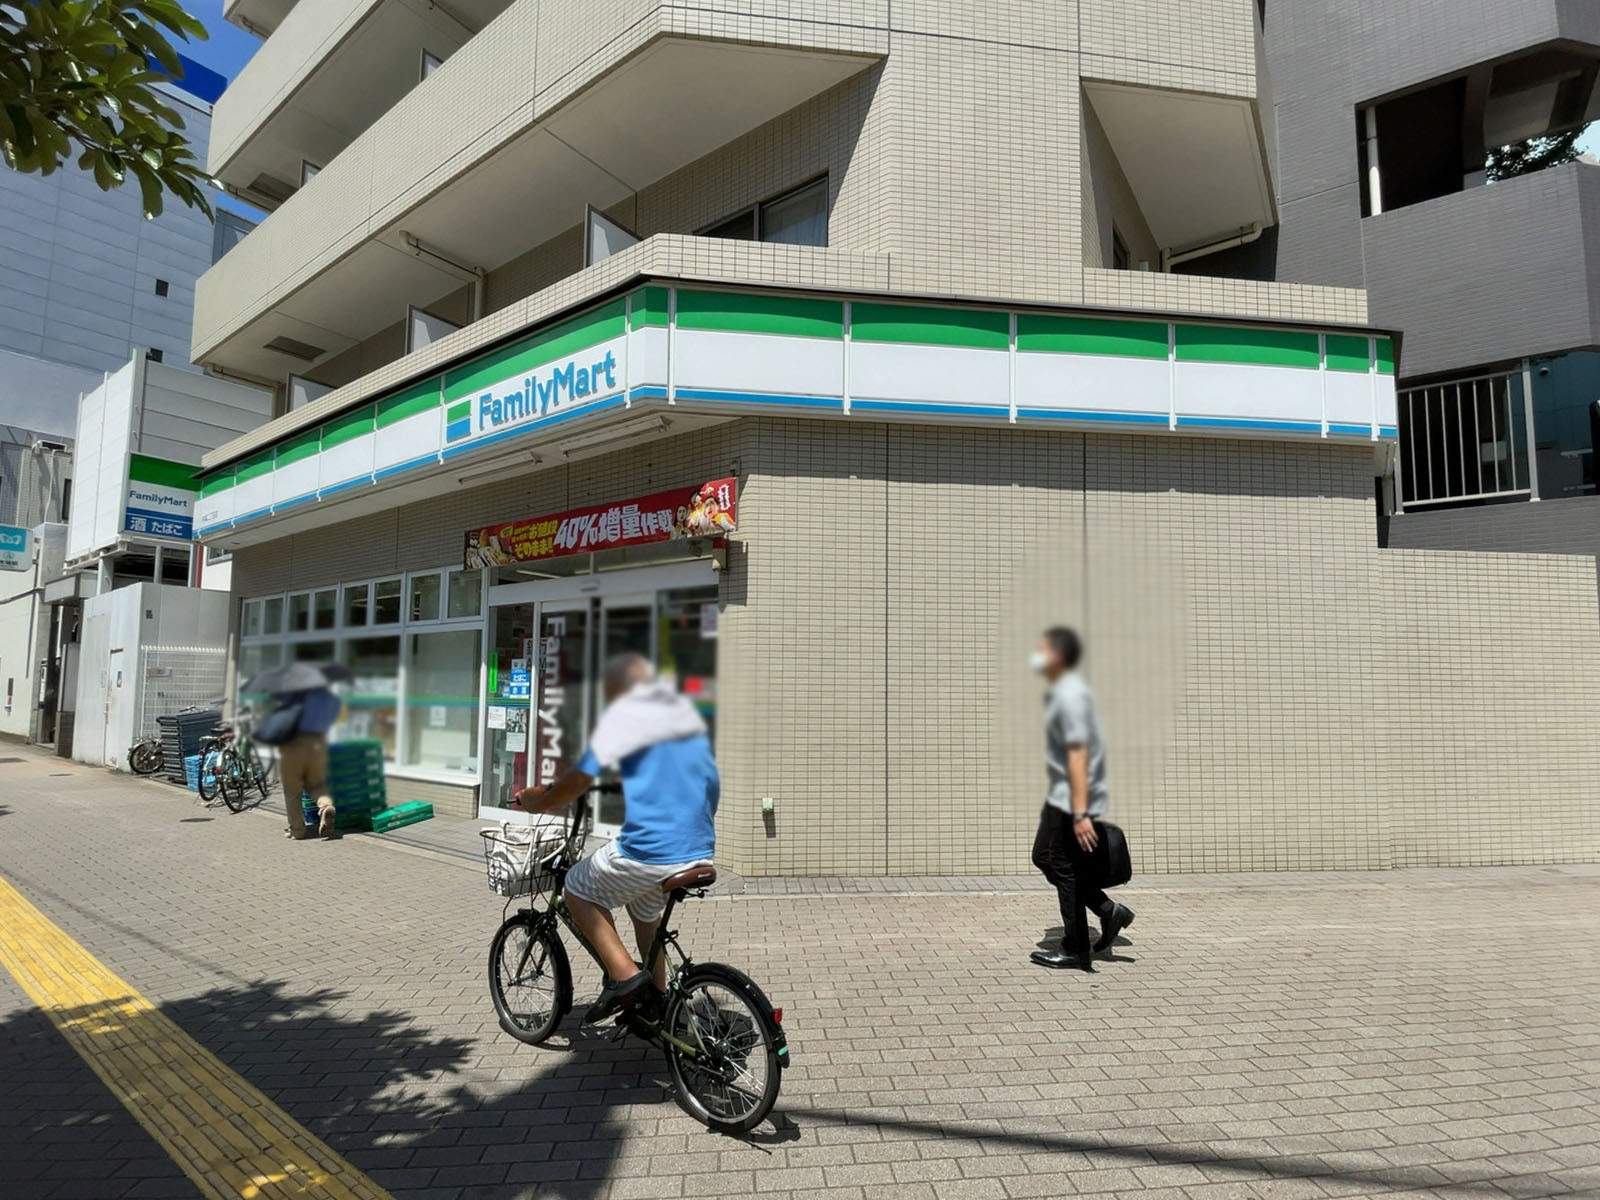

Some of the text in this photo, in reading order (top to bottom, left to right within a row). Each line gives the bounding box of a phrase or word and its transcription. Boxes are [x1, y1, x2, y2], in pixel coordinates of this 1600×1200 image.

[478, 349, 617, 431] FamilyMart
[128, 489, 188, 508] FamilyMart
[130, 516, 184, 536] 酒 たばこ
[553, 503, 676, 550] 40%増量作戦
